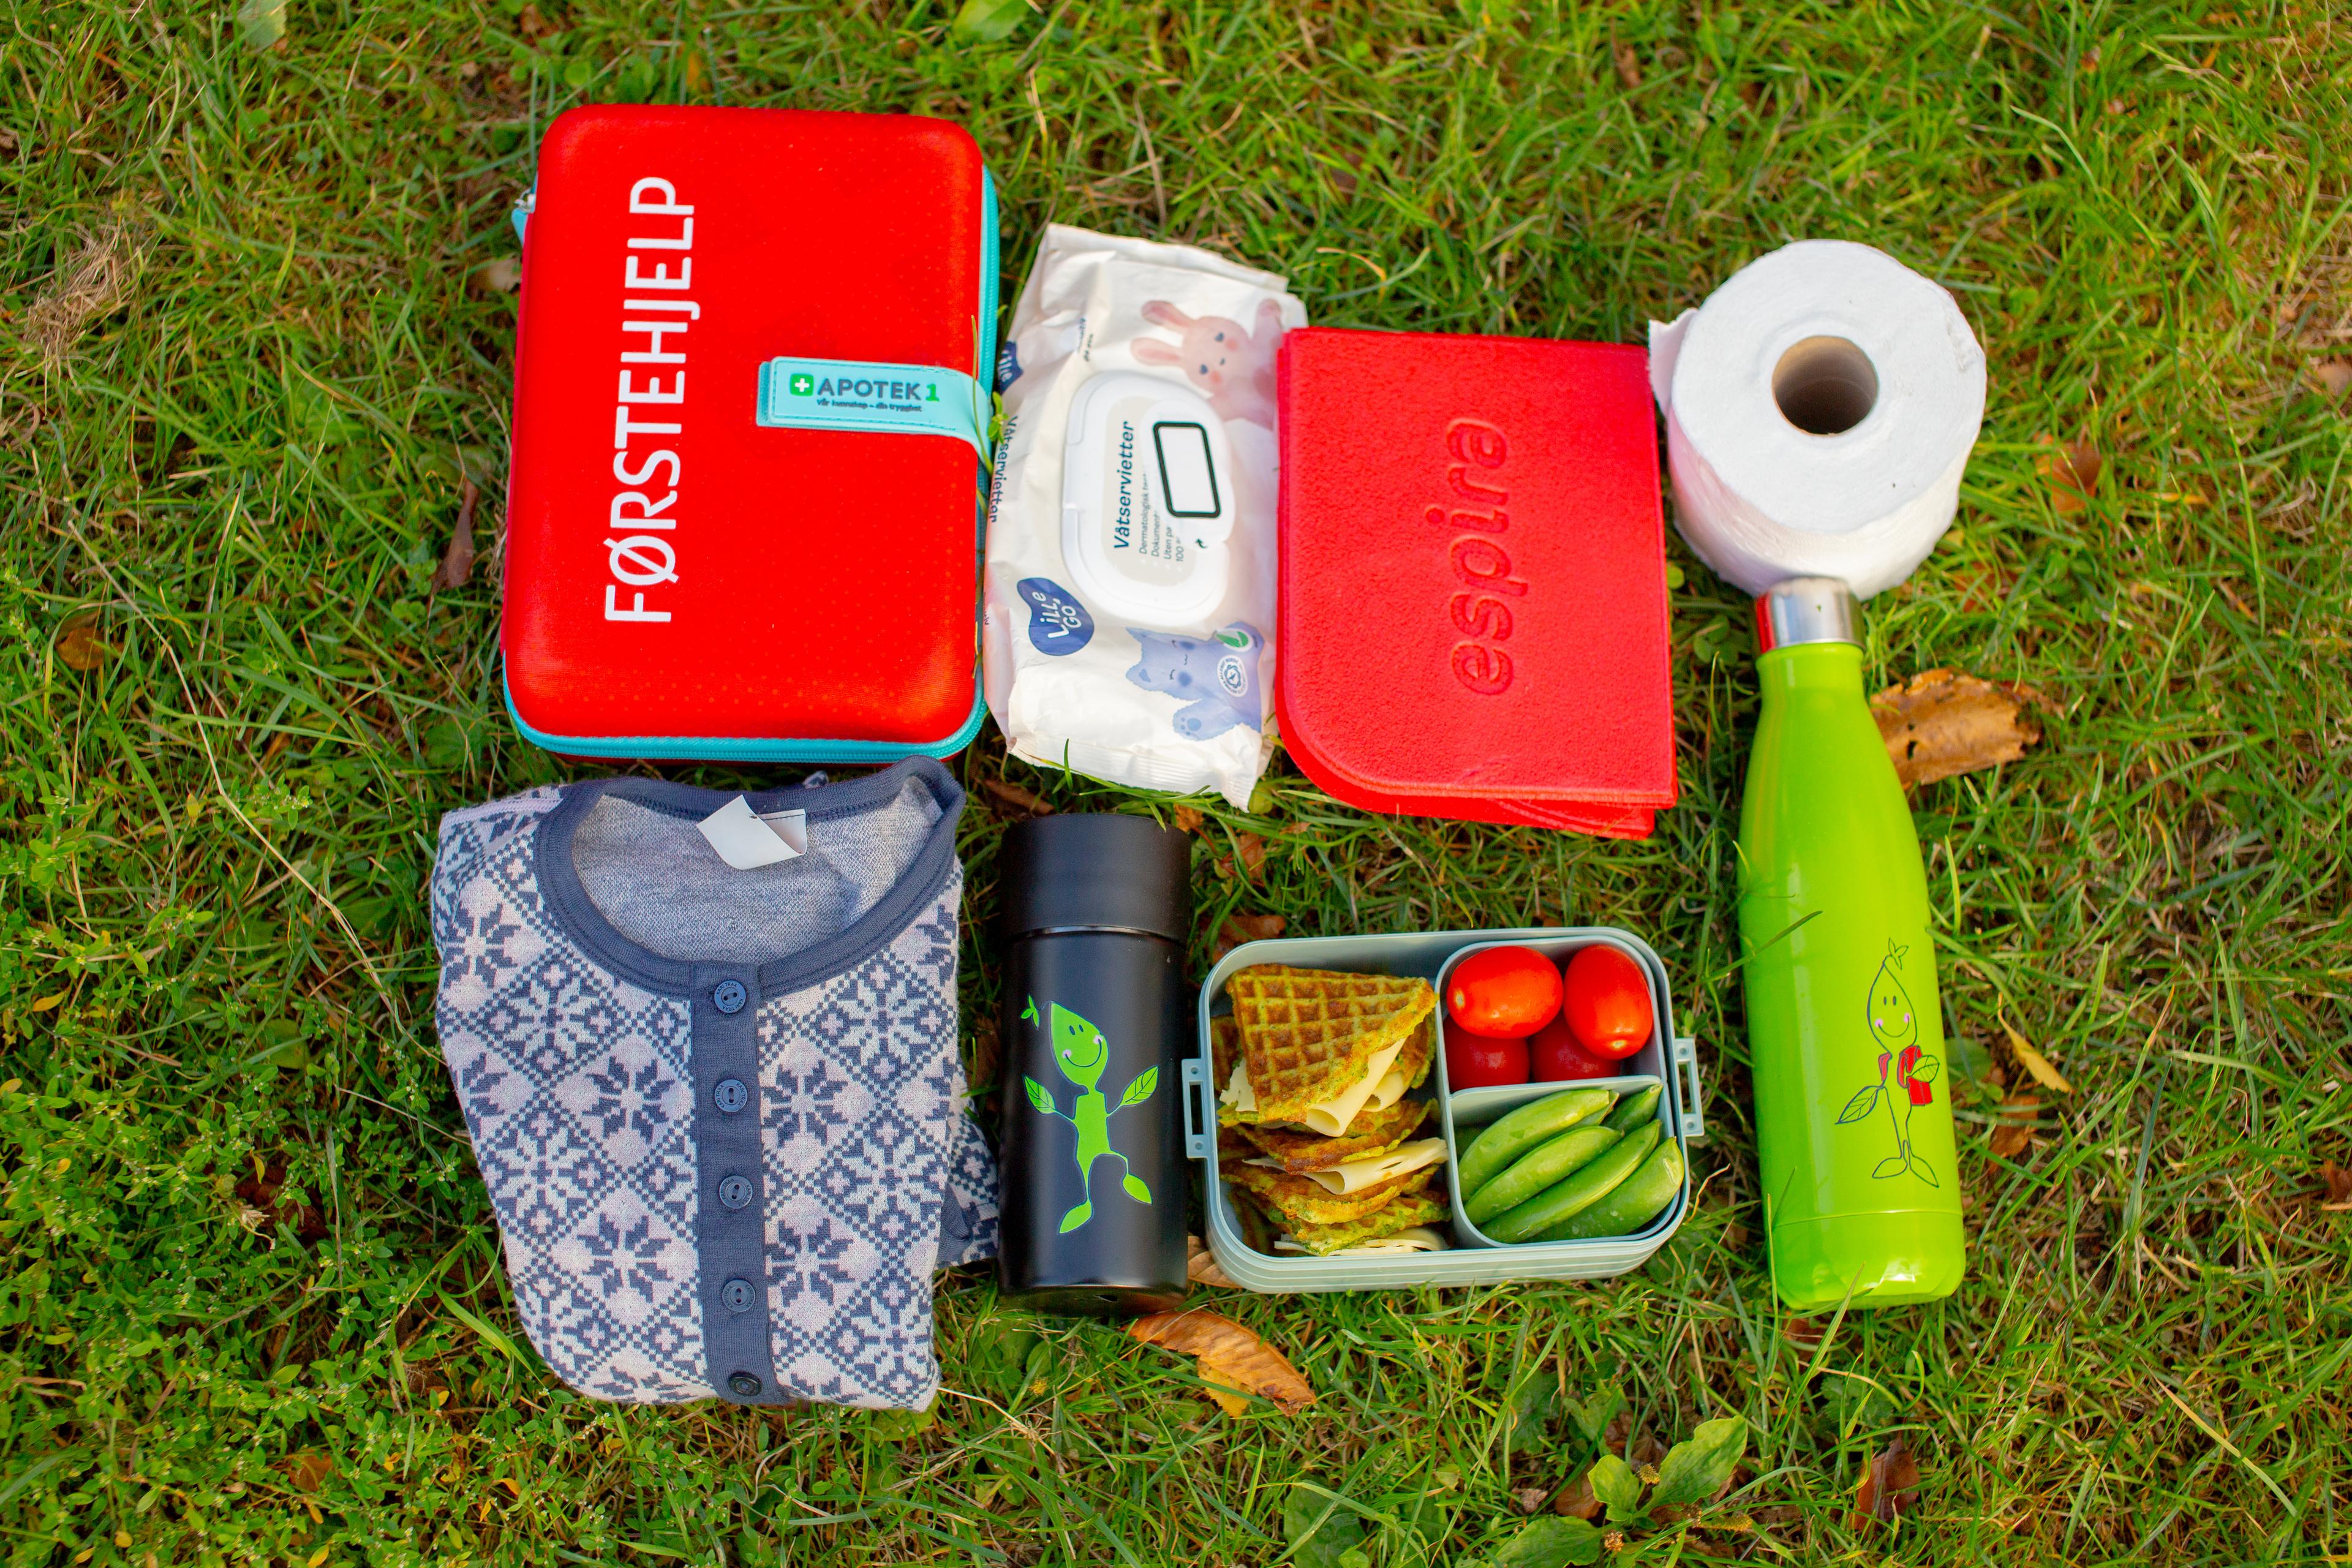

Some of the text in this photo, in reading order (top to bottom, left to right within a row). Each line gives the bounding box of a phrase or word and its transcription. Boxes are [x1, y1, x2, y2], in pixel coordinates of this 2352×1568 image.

[605, 176, 700, 622] FØRSTEHJELP
[817, 378, 940, 402] APOTEK 1
[1114, 421, 1134, 548] Våtservietter
[1139, 492, 1151, 554] Dermatologisk
[1163, 540, 1172, 560] Uten
[1175, 546, 1184, 561] 100
[1425, 418, 1529, 696] espira
[1061, 606, 1082, 628] GO
